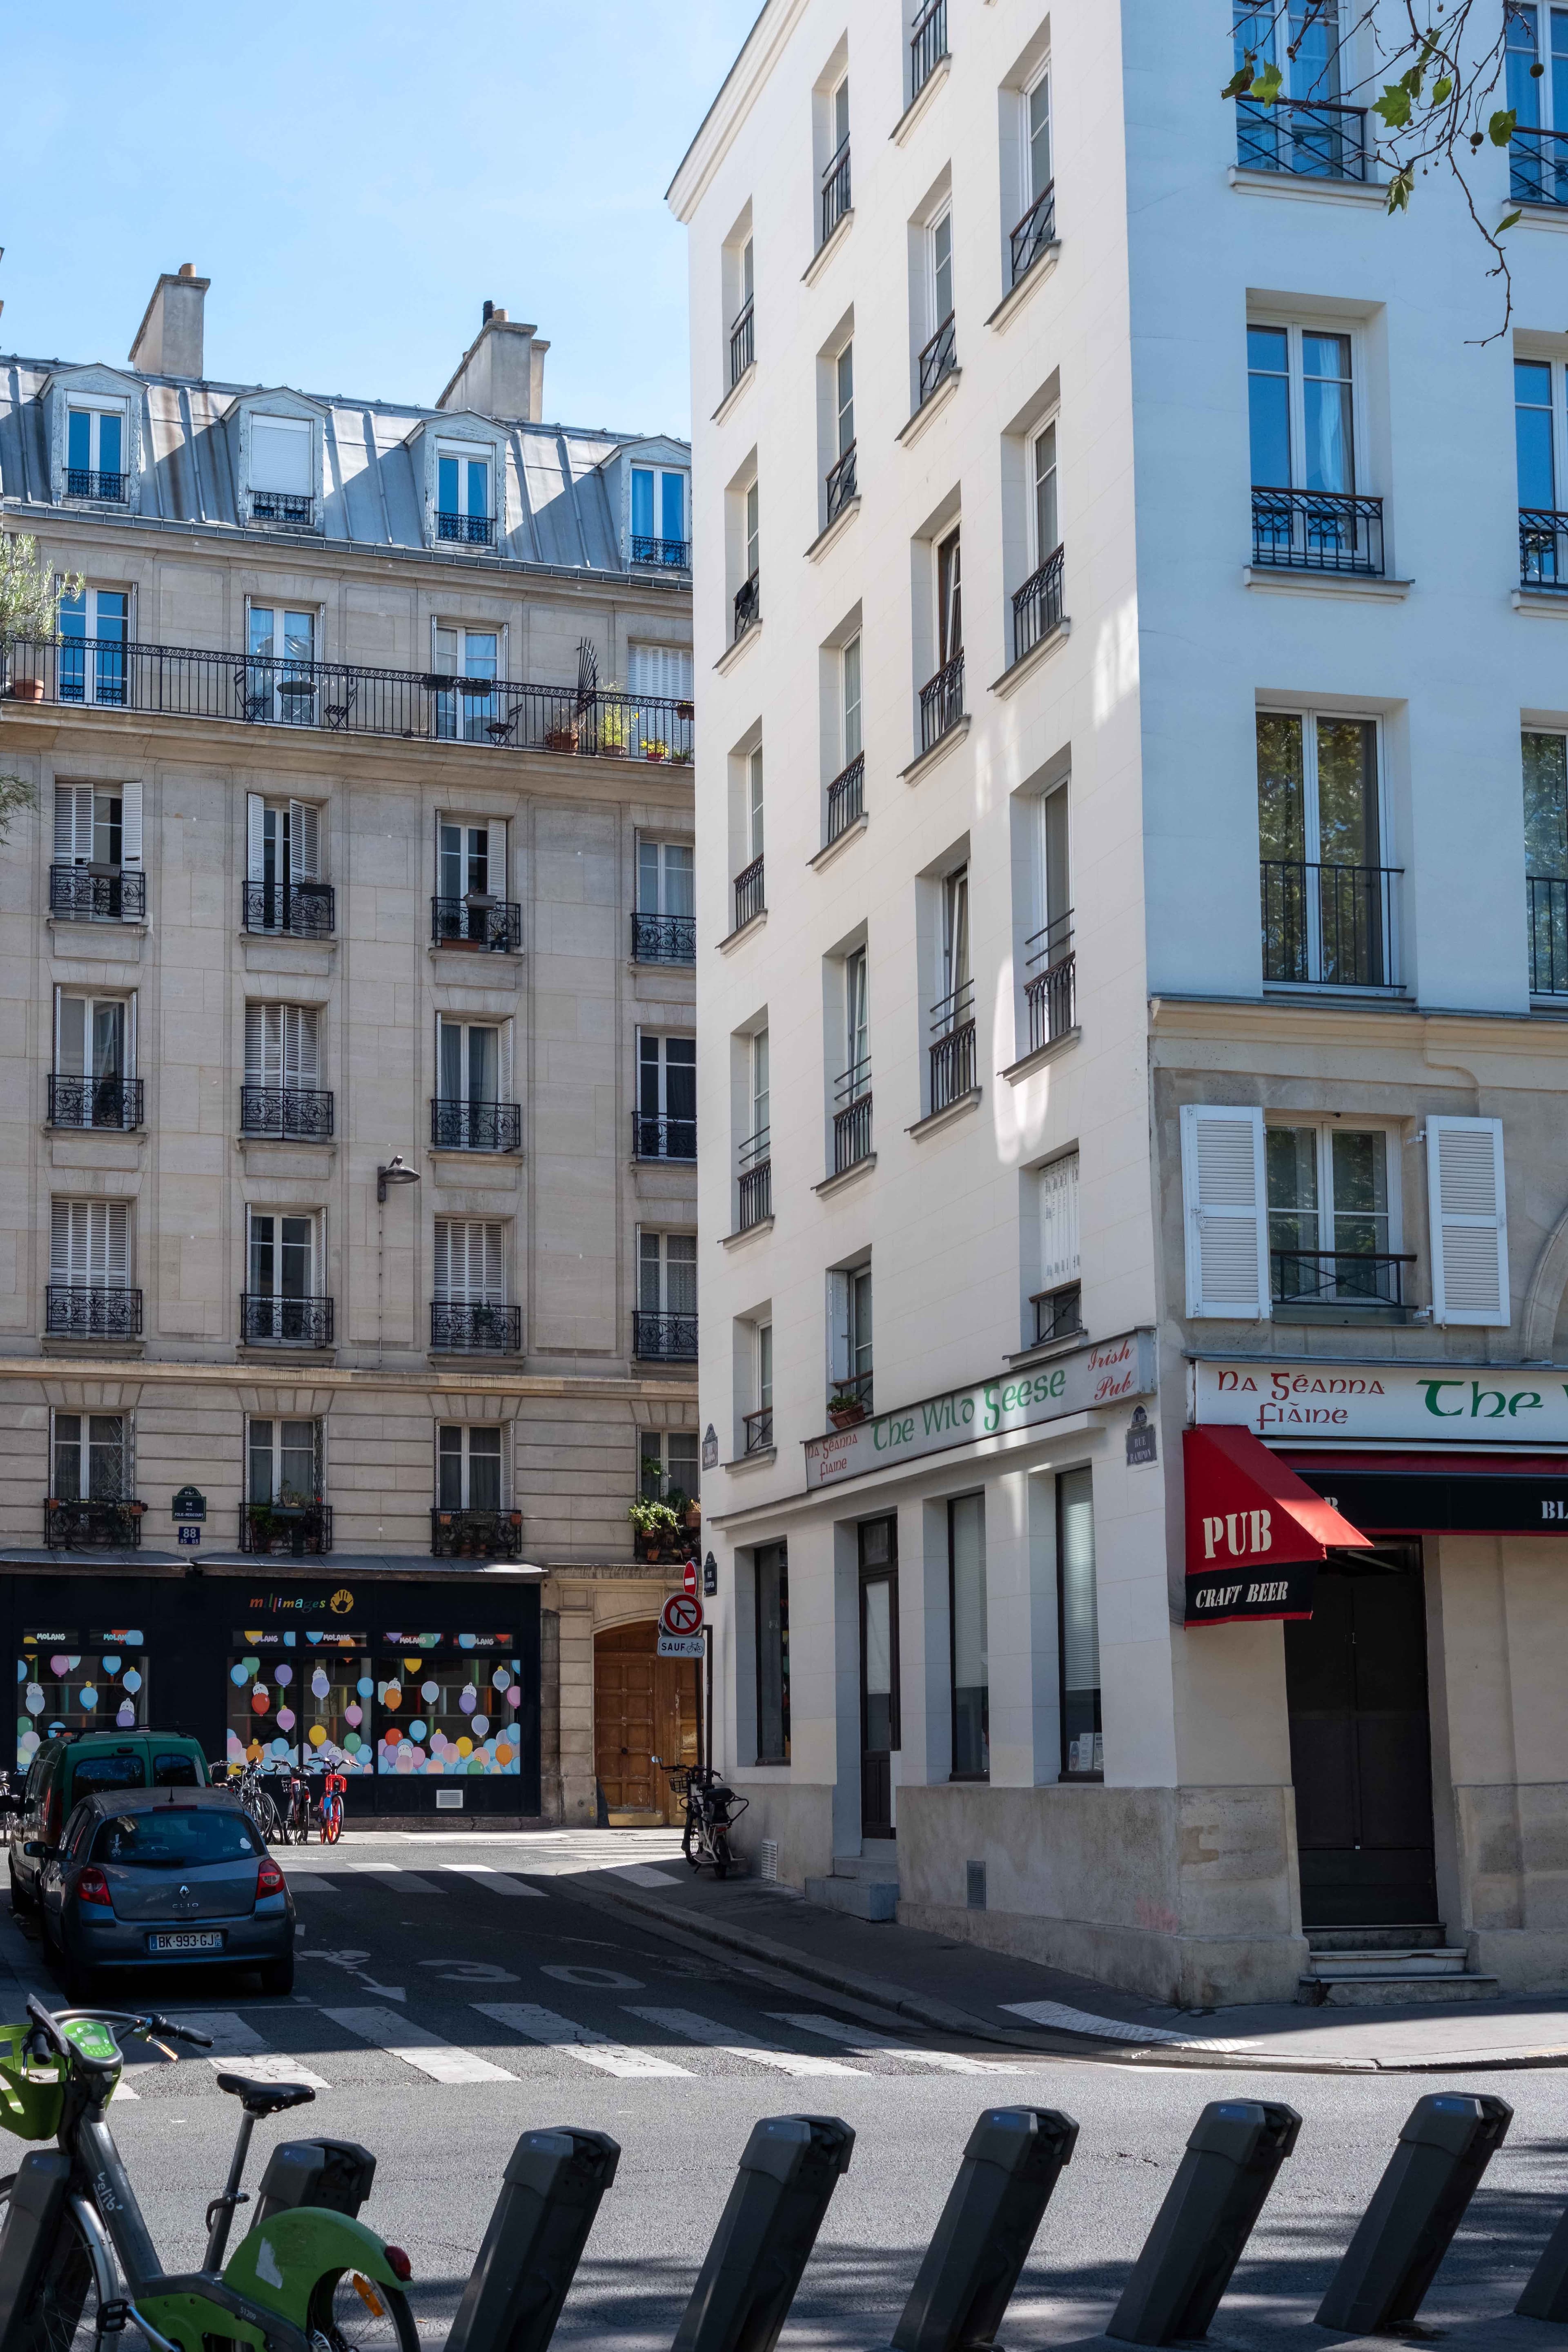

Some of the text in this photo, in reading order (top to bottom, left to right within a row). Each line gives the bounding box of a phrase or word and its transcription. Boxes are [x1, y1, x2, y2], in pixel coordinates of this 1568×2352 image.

[1088, 1339, 1134, 1371] Irish
[1094, 1371, 1134, 1400] Pub
[1416, 1379, 1544, 1417] The
[871, 1369, 1066, 1451] The Wild Geese
[1134, 1436, 1146, 1448] RUE
[1130, 1448, 1151, 1463] RAMPON
[183, 1528, 196, 1538] 88
[1203, 1510, 1272, 1559] PUB
[249, 1593, 326, 1613] millimages
[1196, 1581, 1288, 1608] CRAFT BEER
[662, 1643, 686, 1651] SAUF
[158, 1934, 214, 1948] BK-993-GJ
